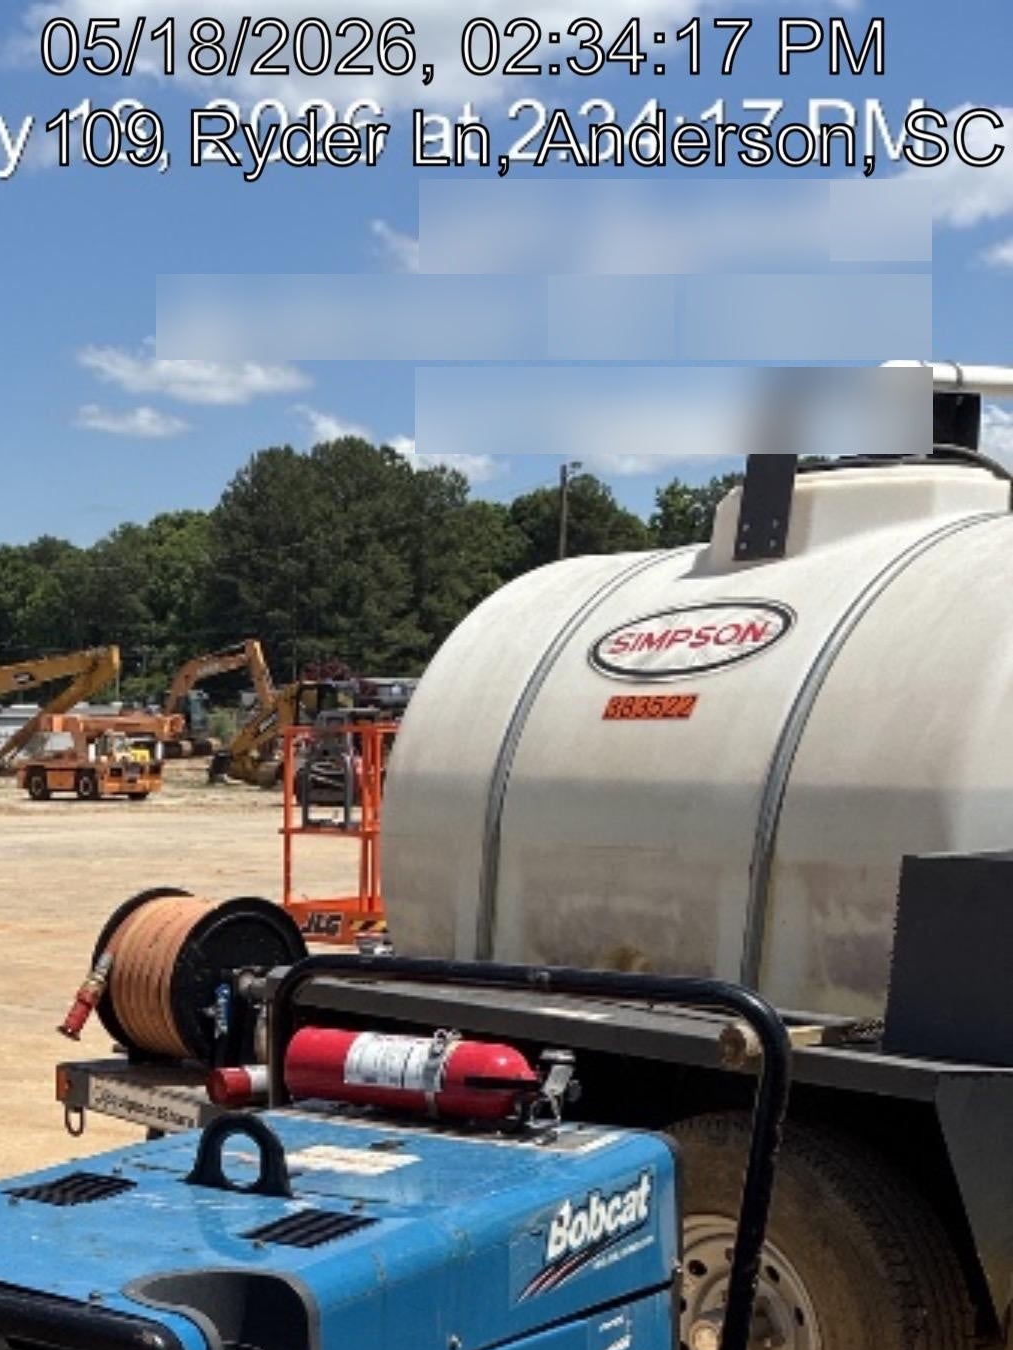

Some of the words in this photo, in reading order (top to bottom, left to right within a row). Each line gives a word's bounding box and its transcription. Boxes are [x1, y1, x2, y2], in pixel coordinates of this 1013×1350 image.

[607, 620, 771, 655] SIMPSON
[300, 912, 342, 936] JLG
[545, 1173, 652, 1263] Bobcat
